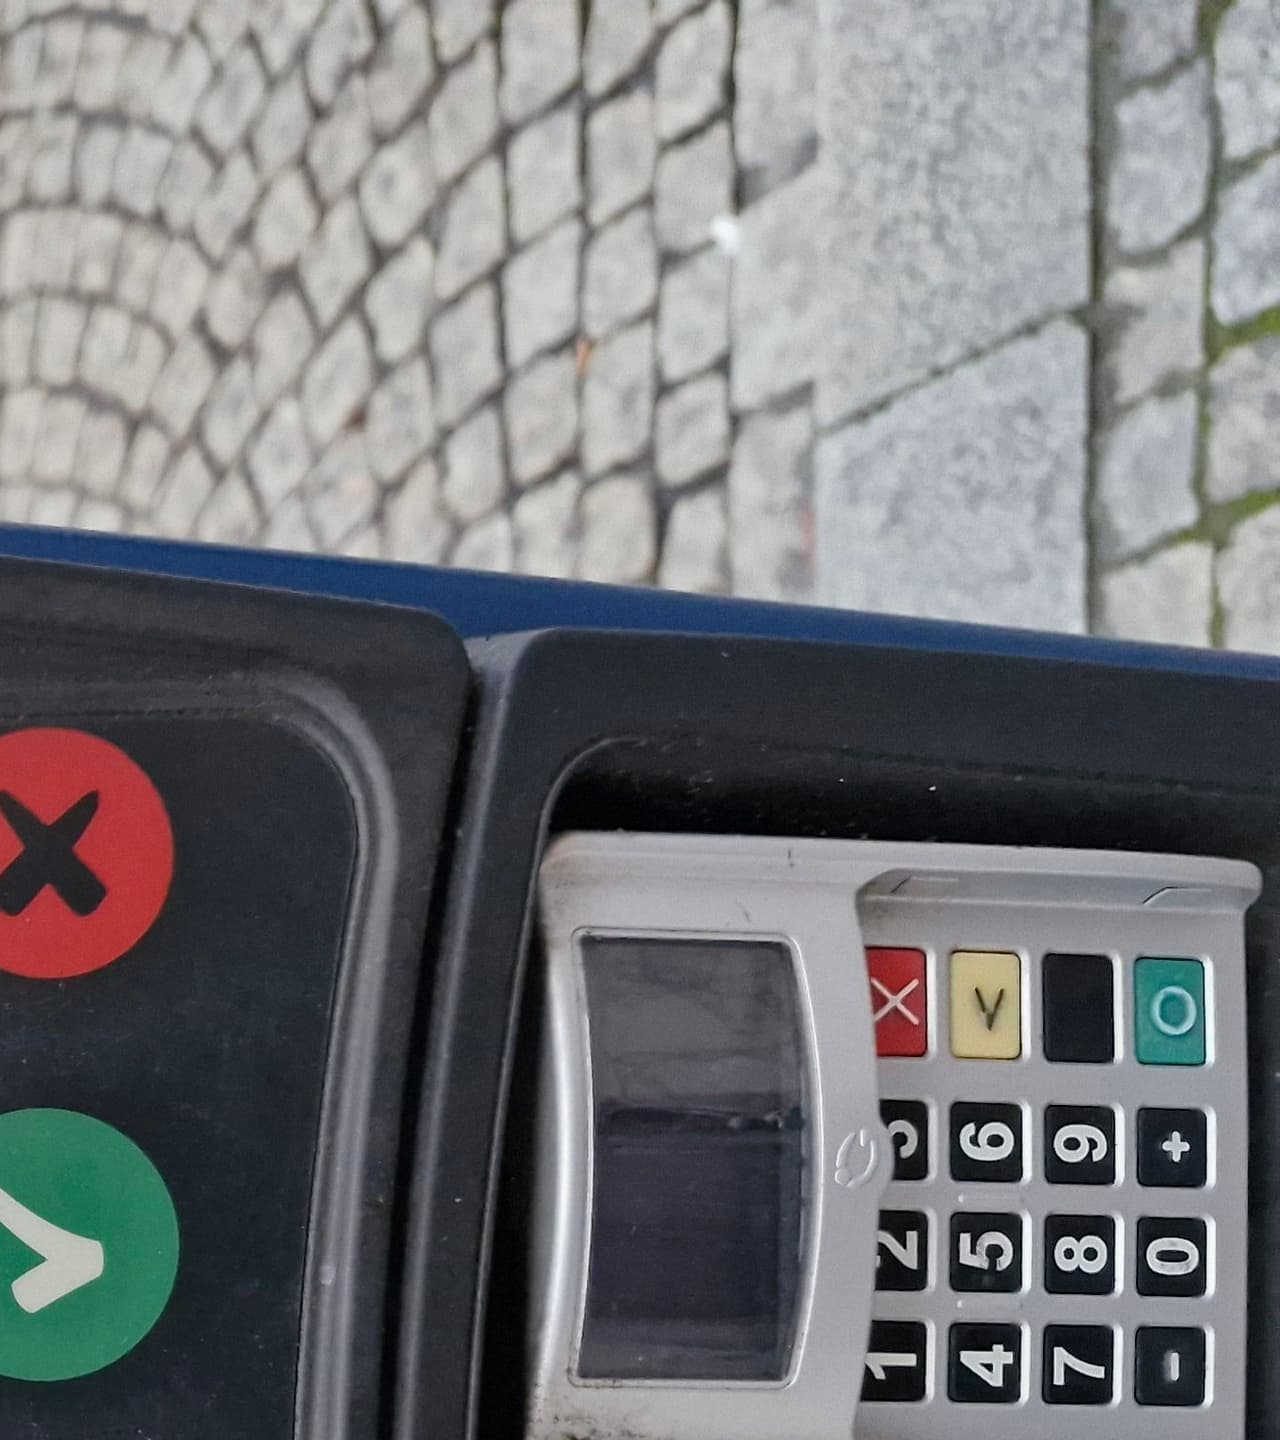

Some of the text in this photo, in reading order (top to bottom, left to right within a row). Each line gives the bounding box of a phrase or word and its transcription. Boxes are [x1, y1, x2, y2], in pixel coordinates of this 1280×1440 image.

[960, 1121, 1014, 1162] 6
[1054, 1123, 1107, 1164] 9
[877, 1230, 918, 1269] 2
[959, 1231, 1014, 1271] 5
[1054, 1233, 1107, 1274] 8
[1146, 1237, 1199, 1276] 0
[865, 1353, 918, 1379] 1
[960, 1343, 1014, 1387] 4
[1054, 1345, 1106, 1386] 7
